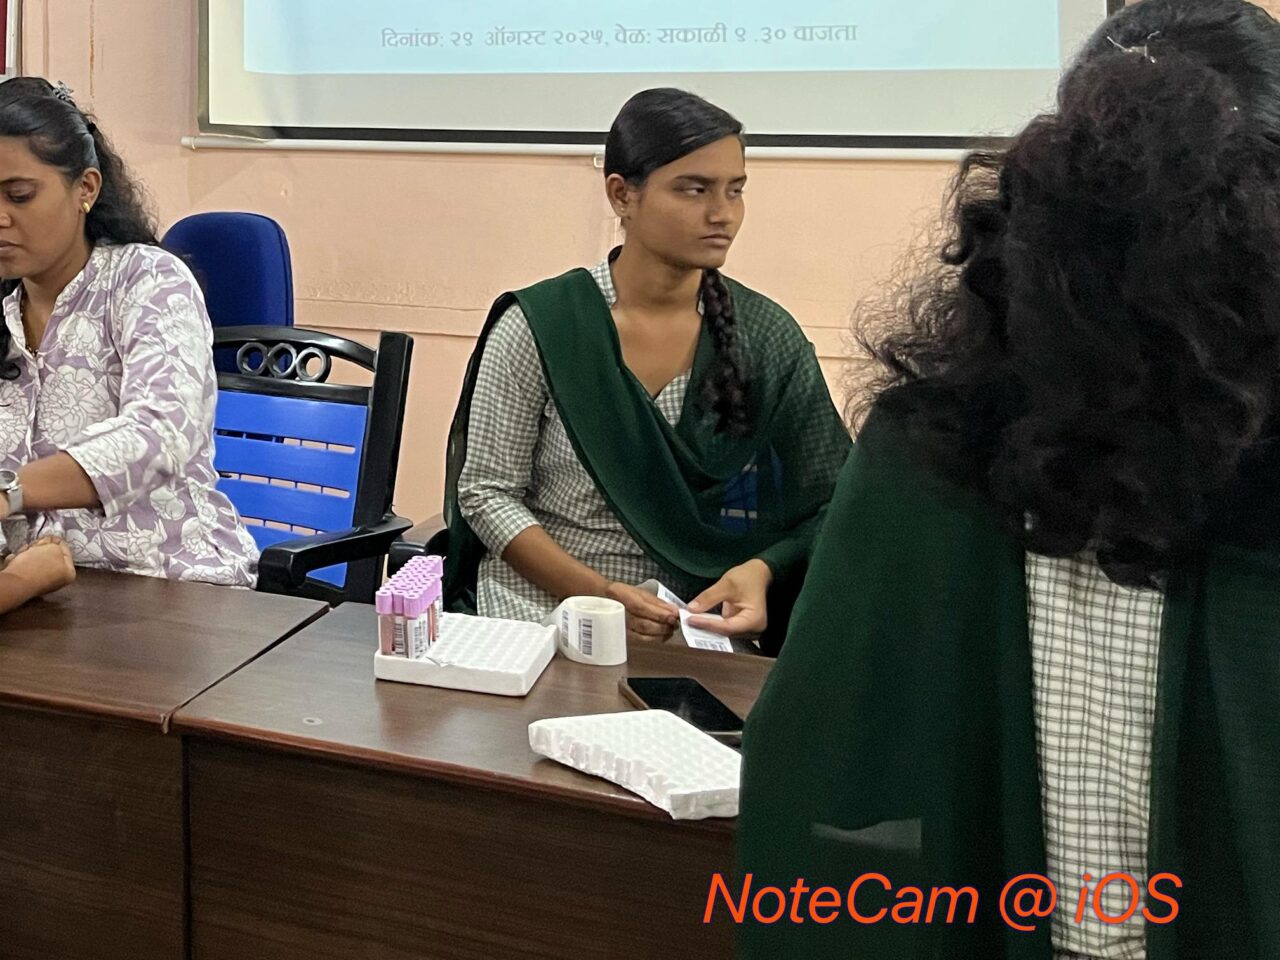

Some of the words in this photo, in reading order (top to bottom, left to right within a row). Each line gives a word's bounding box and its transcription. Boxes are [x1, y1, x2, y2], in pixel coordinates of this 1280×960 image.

[484, 26, 546, 47] ऑगस्ट
[656, 22, 727, 45] सकाळी
[793, 24, 858, 42] वाजता
